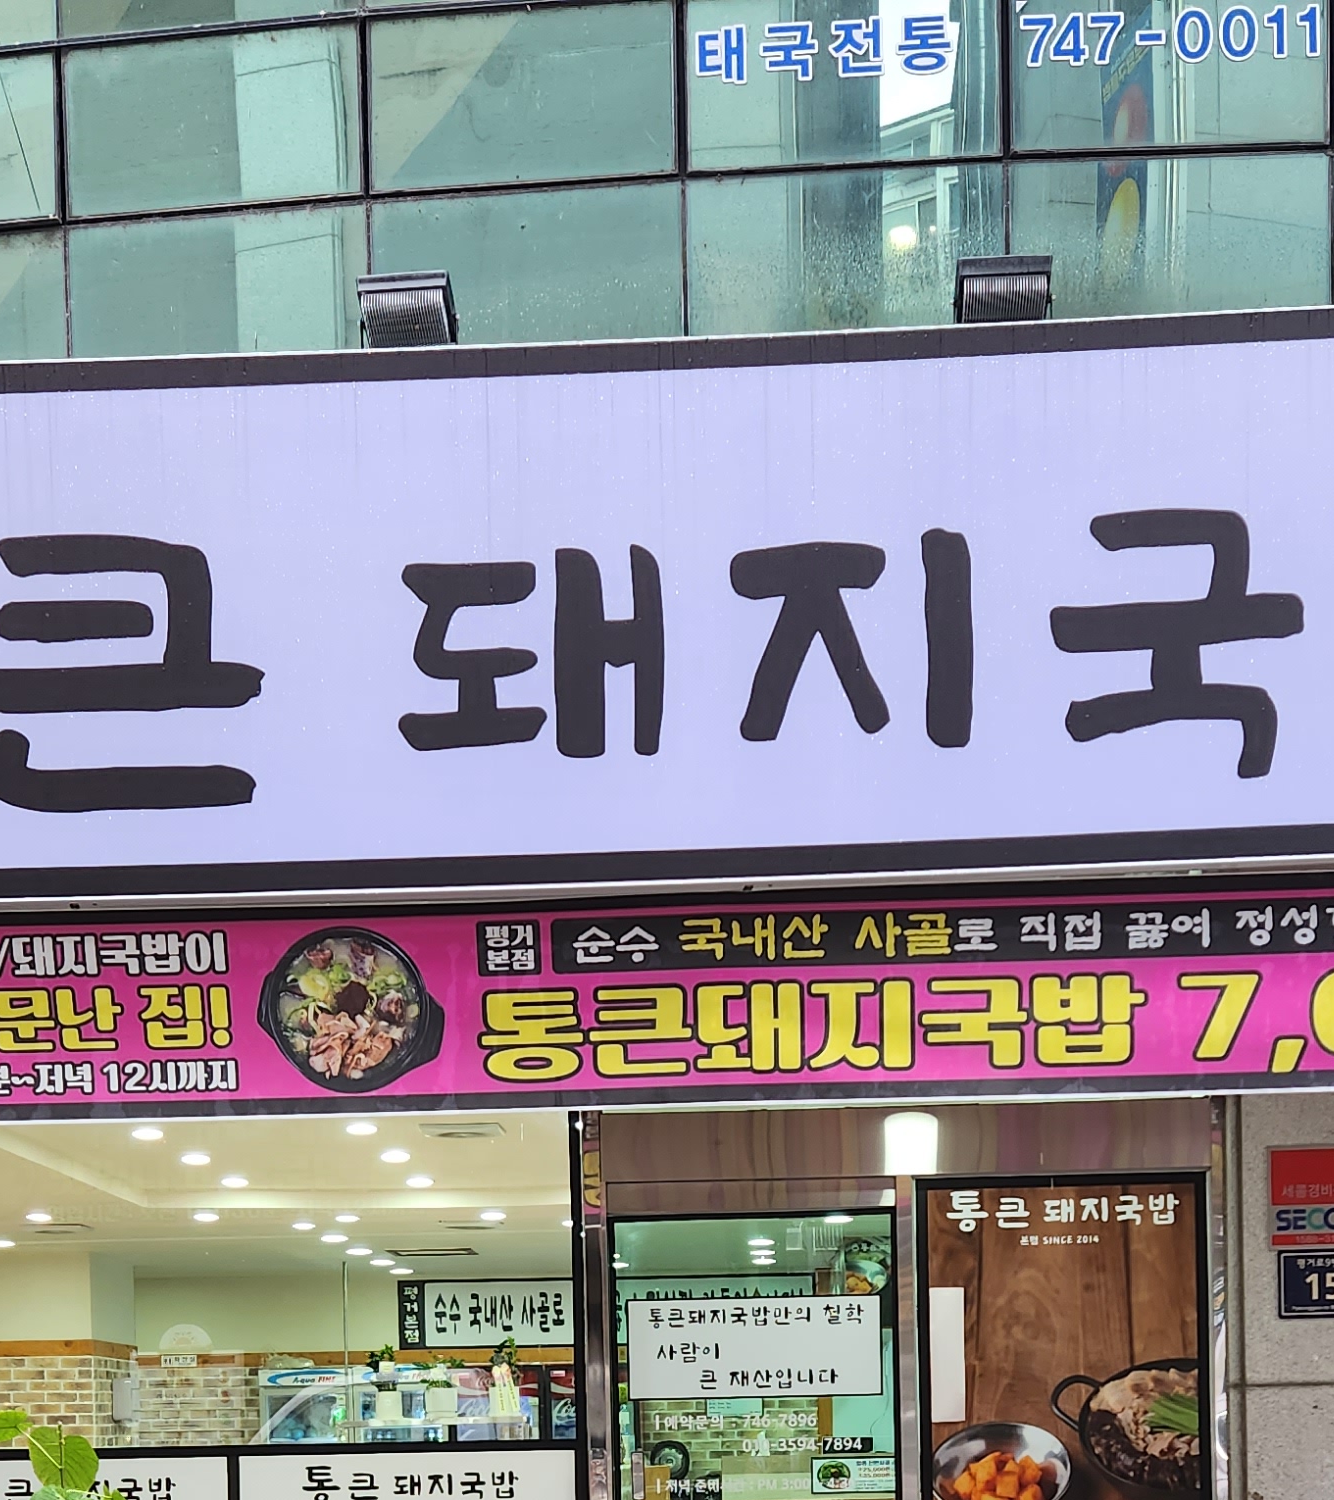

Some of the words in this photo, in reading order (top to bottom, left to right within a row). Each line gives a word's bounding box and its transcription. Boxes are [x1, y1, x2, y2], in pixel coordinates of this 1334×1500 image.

[696, 14, 954, 84] 태국전통
[1019, 3, 1322, 67] 747-0011
[485, 925, 534, 946] 평거
[572, 925, 659, 964] 순수
[678, 913, 829, 961] 국내산
[854, 911, 998, 957] 사골로
[1020, 911, 1102, 952] 직접
[1125, 907, 1211, 950] 끓여
[486, 949, 535, 972] 본점
[138, 983, 234, 1049] 집!
[478, 971, 1148, 1082] 통큰돼지국밥
[102, 1058, 239, 1092] 12시까지
[946, 1190, 1030, 1232] 통큰
[1043, 1193, 1181, 1226] 돼지국밥
[1042, 1235, 1073, 1245] SINCE
[1076, 1235, 1099, 1244] 2014
[403, 1285, 419, 1345] 평거본점
[434, 1292, 461, 1335] 순수
[469, 1293, 513, 1333] 국내산
[521, 1291, 565, 1333] 사골로
[648, 1306, 811, 1329] 통큰돼지국밥만의
[823, 1303, 864, 1324] 철학
[657, 1342, 720, 1363] 사람이
[699, 1370, 717, 1390] 큰
[730, 1368, 839, 1389] 재산입니다
[664, 1414, 724, 1430] 예약문의
[742, 1413, 817, 1427] 746-7896
[393, 1470, 519, 1500] 돼지국밥
